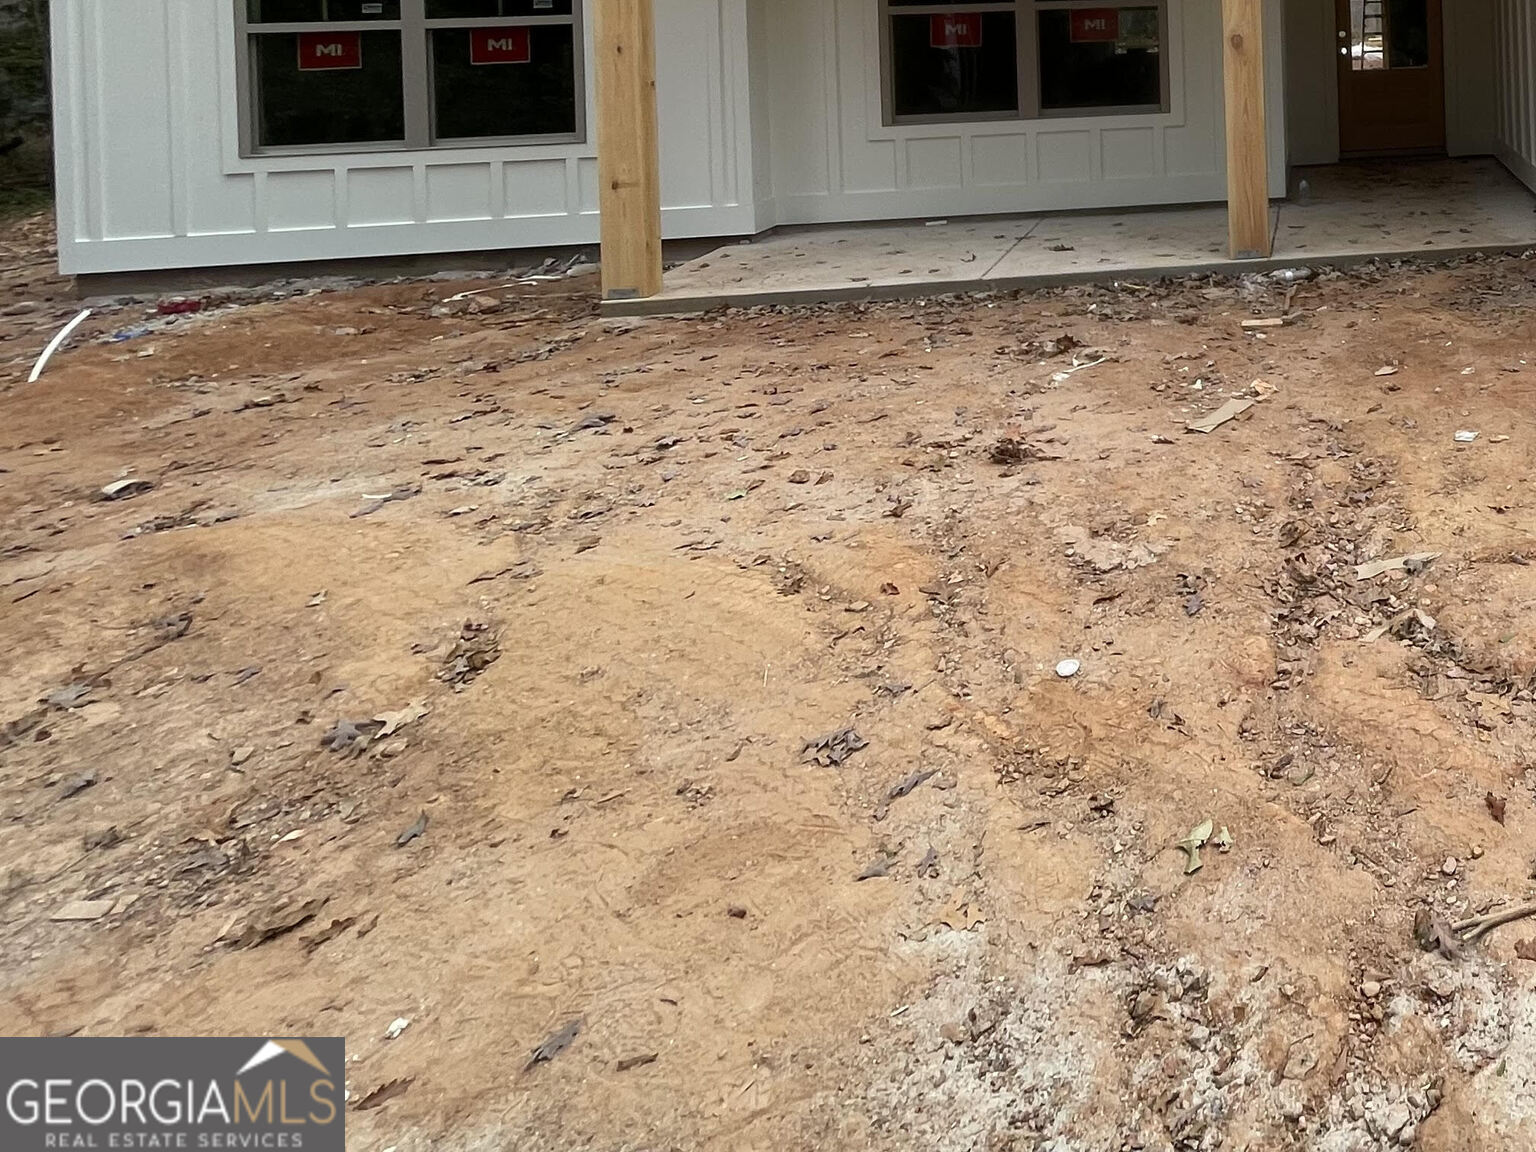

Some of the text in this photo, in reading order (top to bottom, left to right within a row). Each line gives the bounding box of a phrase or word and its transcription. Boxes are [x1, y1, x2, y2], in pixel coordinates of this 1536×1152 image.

[944, 23, 967, 36] MI
[315, 43, 342, 57] MI
[487, 38, 513, 52] MI
